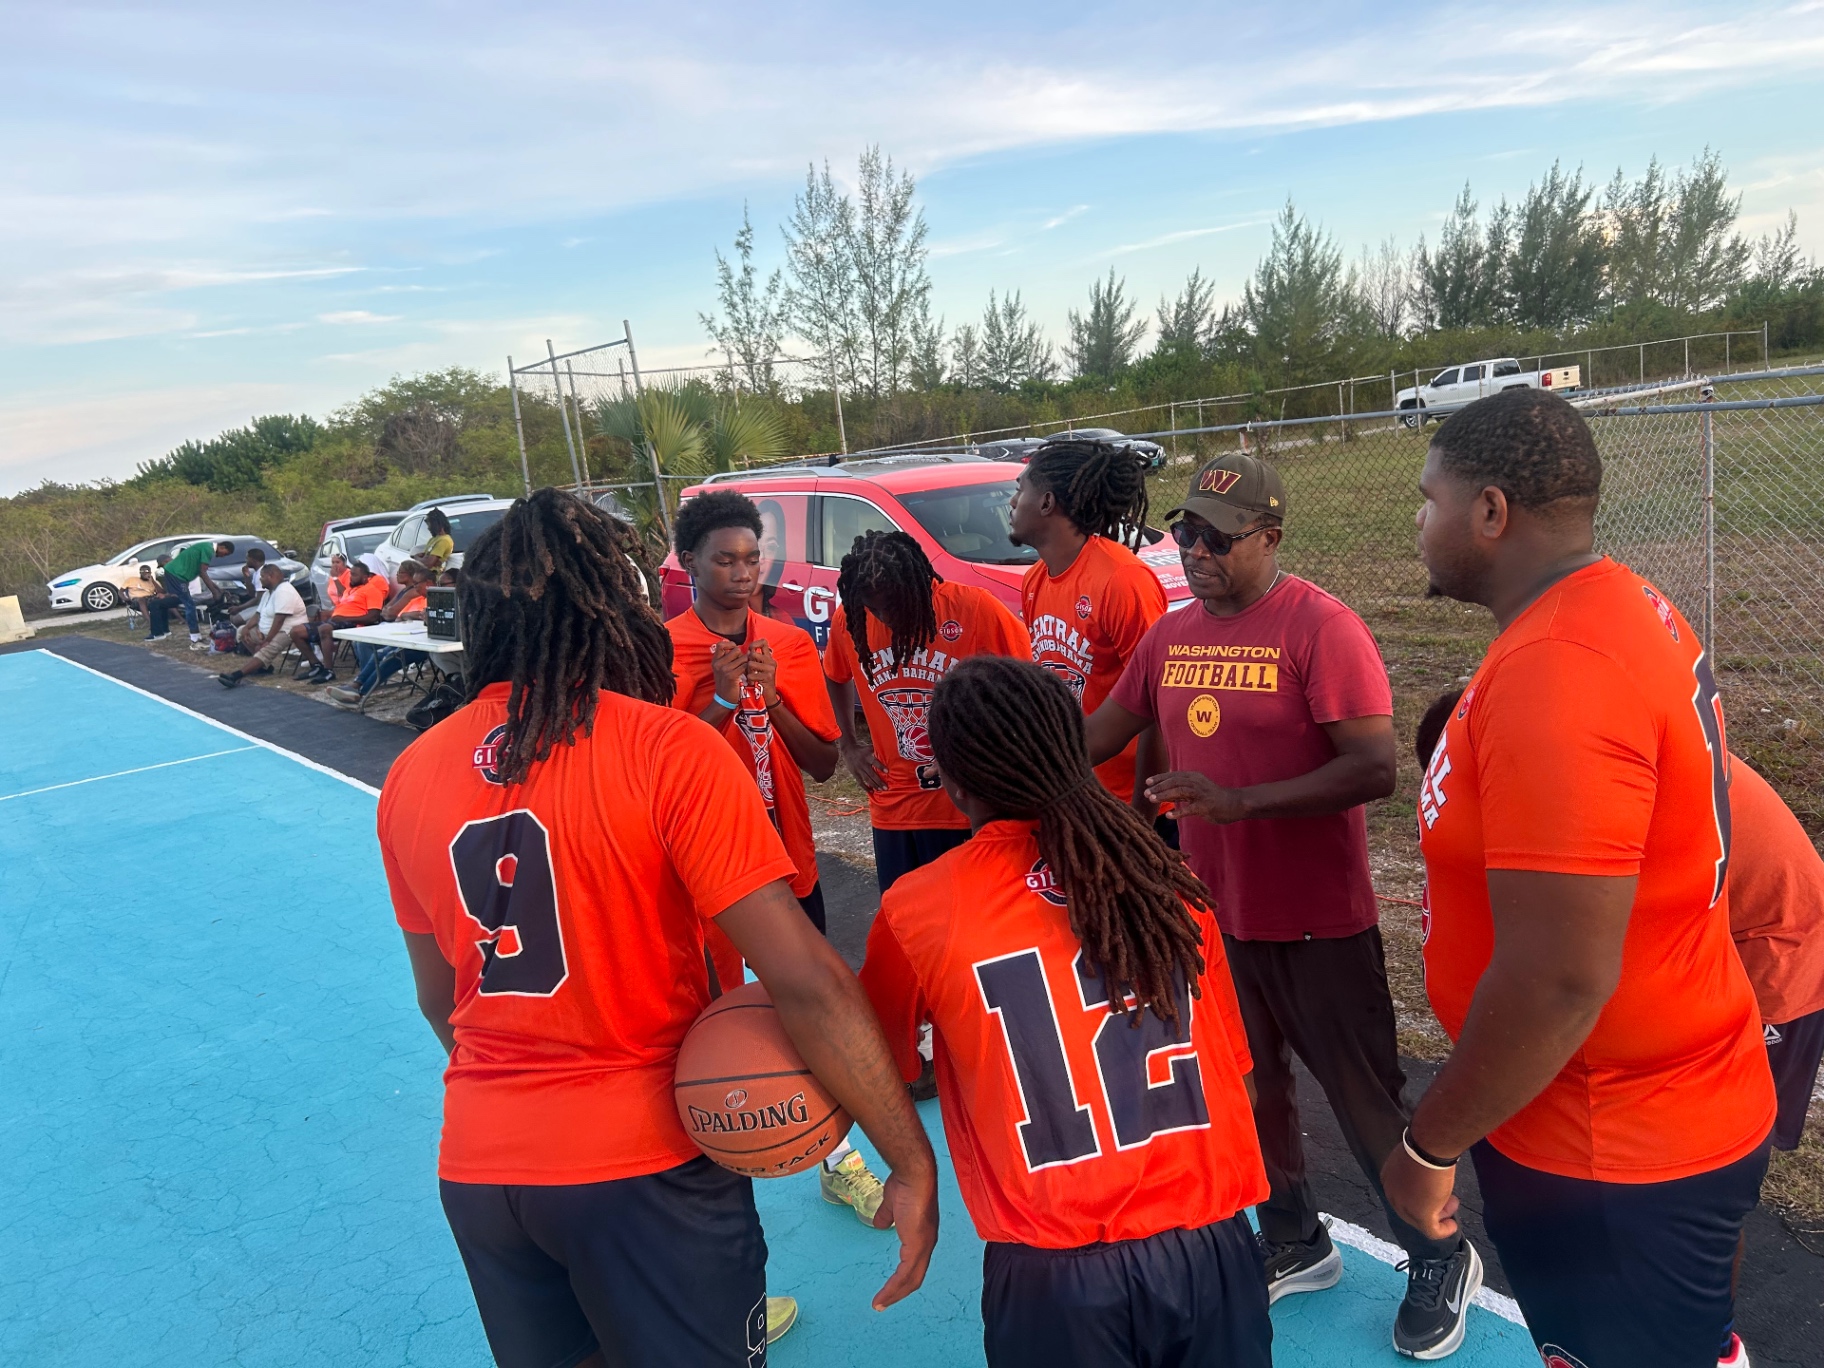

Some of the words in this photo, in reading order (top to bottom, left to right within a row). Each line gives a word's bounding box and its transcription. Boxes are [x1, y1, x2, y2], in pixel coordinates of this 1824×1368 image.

[1168, 645, 1280, 659] WASHINGTON
[1164, 663, 1271, 689] FOOTBALL
[1196, 710, 1212, 723] W
[449, 808, 569, 998] 9
[972, 946, 1211, 1174] 12
[687, 1091, 809, 1133] SPALDING
[774, 1131, 831, 1169] TACK
